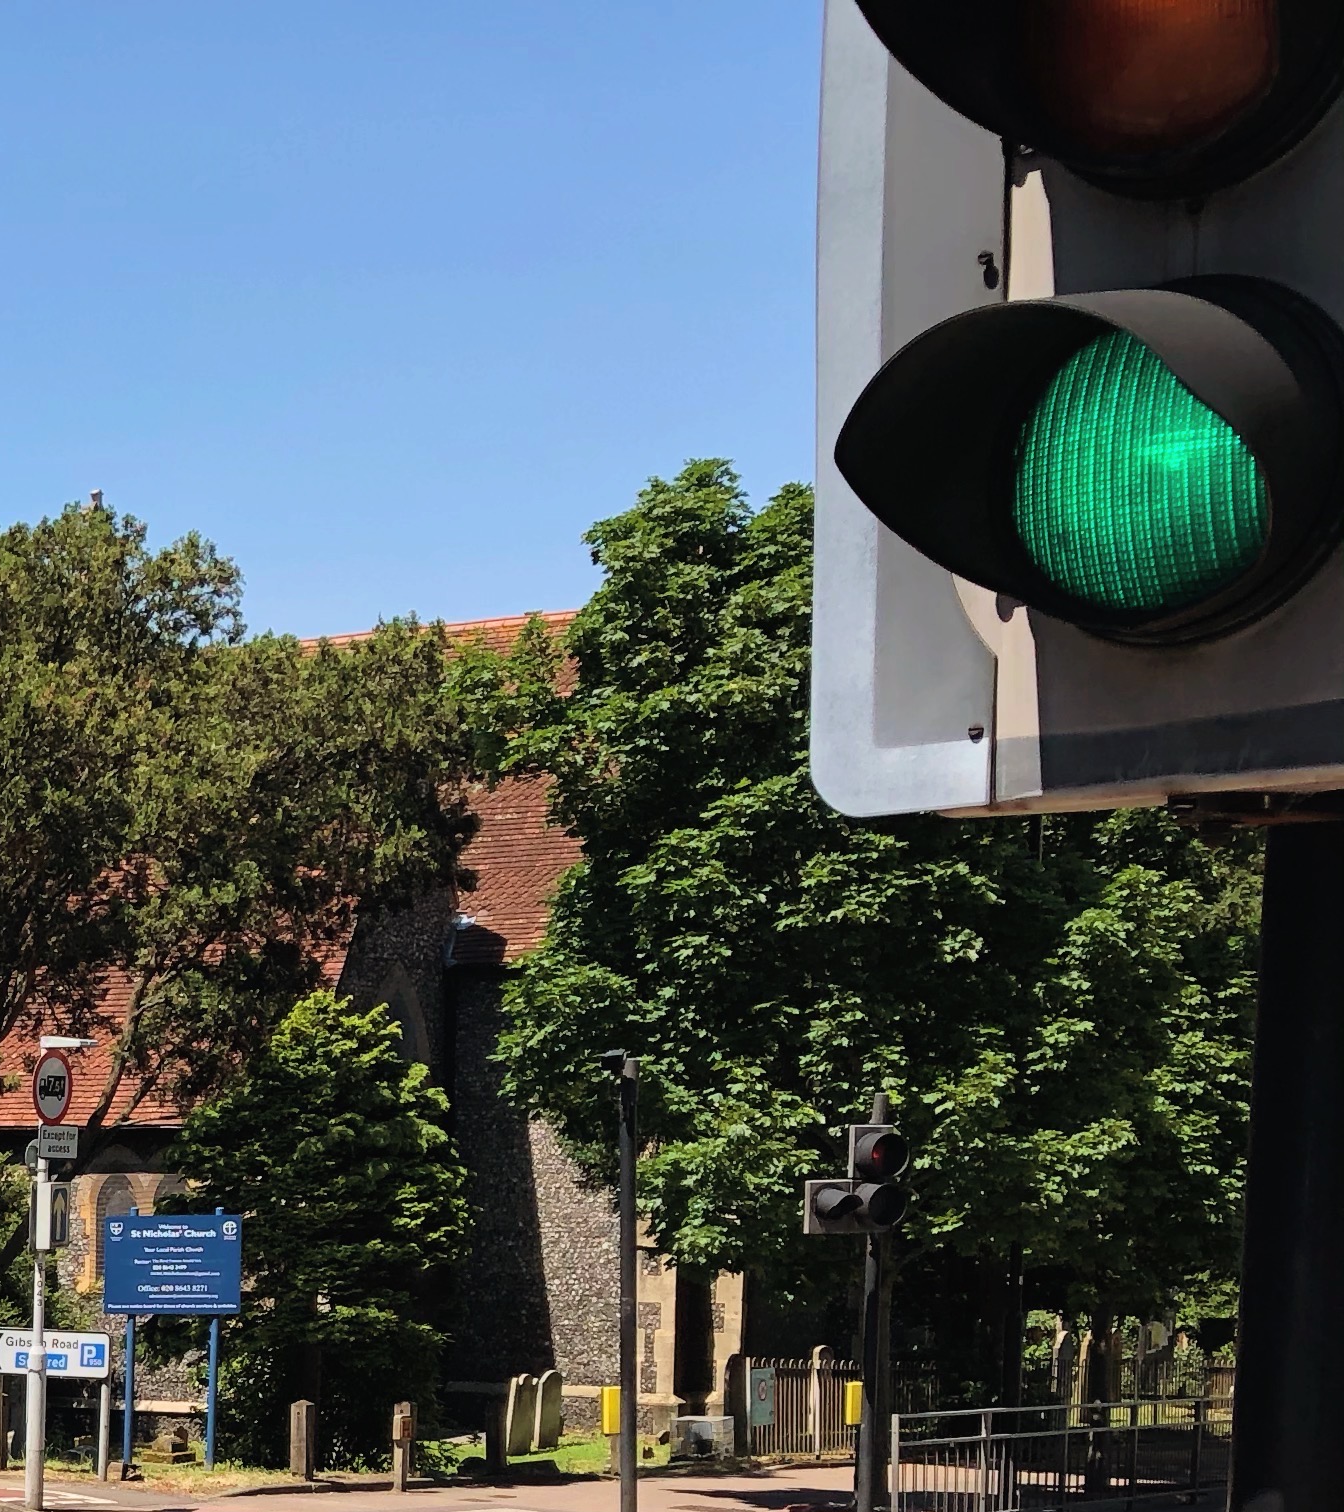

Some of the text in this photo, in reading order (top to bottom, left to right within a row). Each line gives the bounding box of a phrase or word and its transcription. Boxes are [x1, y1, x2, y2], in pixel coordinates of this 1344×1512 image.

[42, 1129, 76, 1141] Except for
[47, 1145, 70, 1154] access
[130, 1229, 141, 1238] St
[142, 1229, 183, 1238] Nicholas'
[184, 1229, 217, 1238] Church
[137, 1284, 160, 1292] Office:
[5, 1336, 79, 1349] Gibsn Road
[82, 1345, 97, 1366] P
